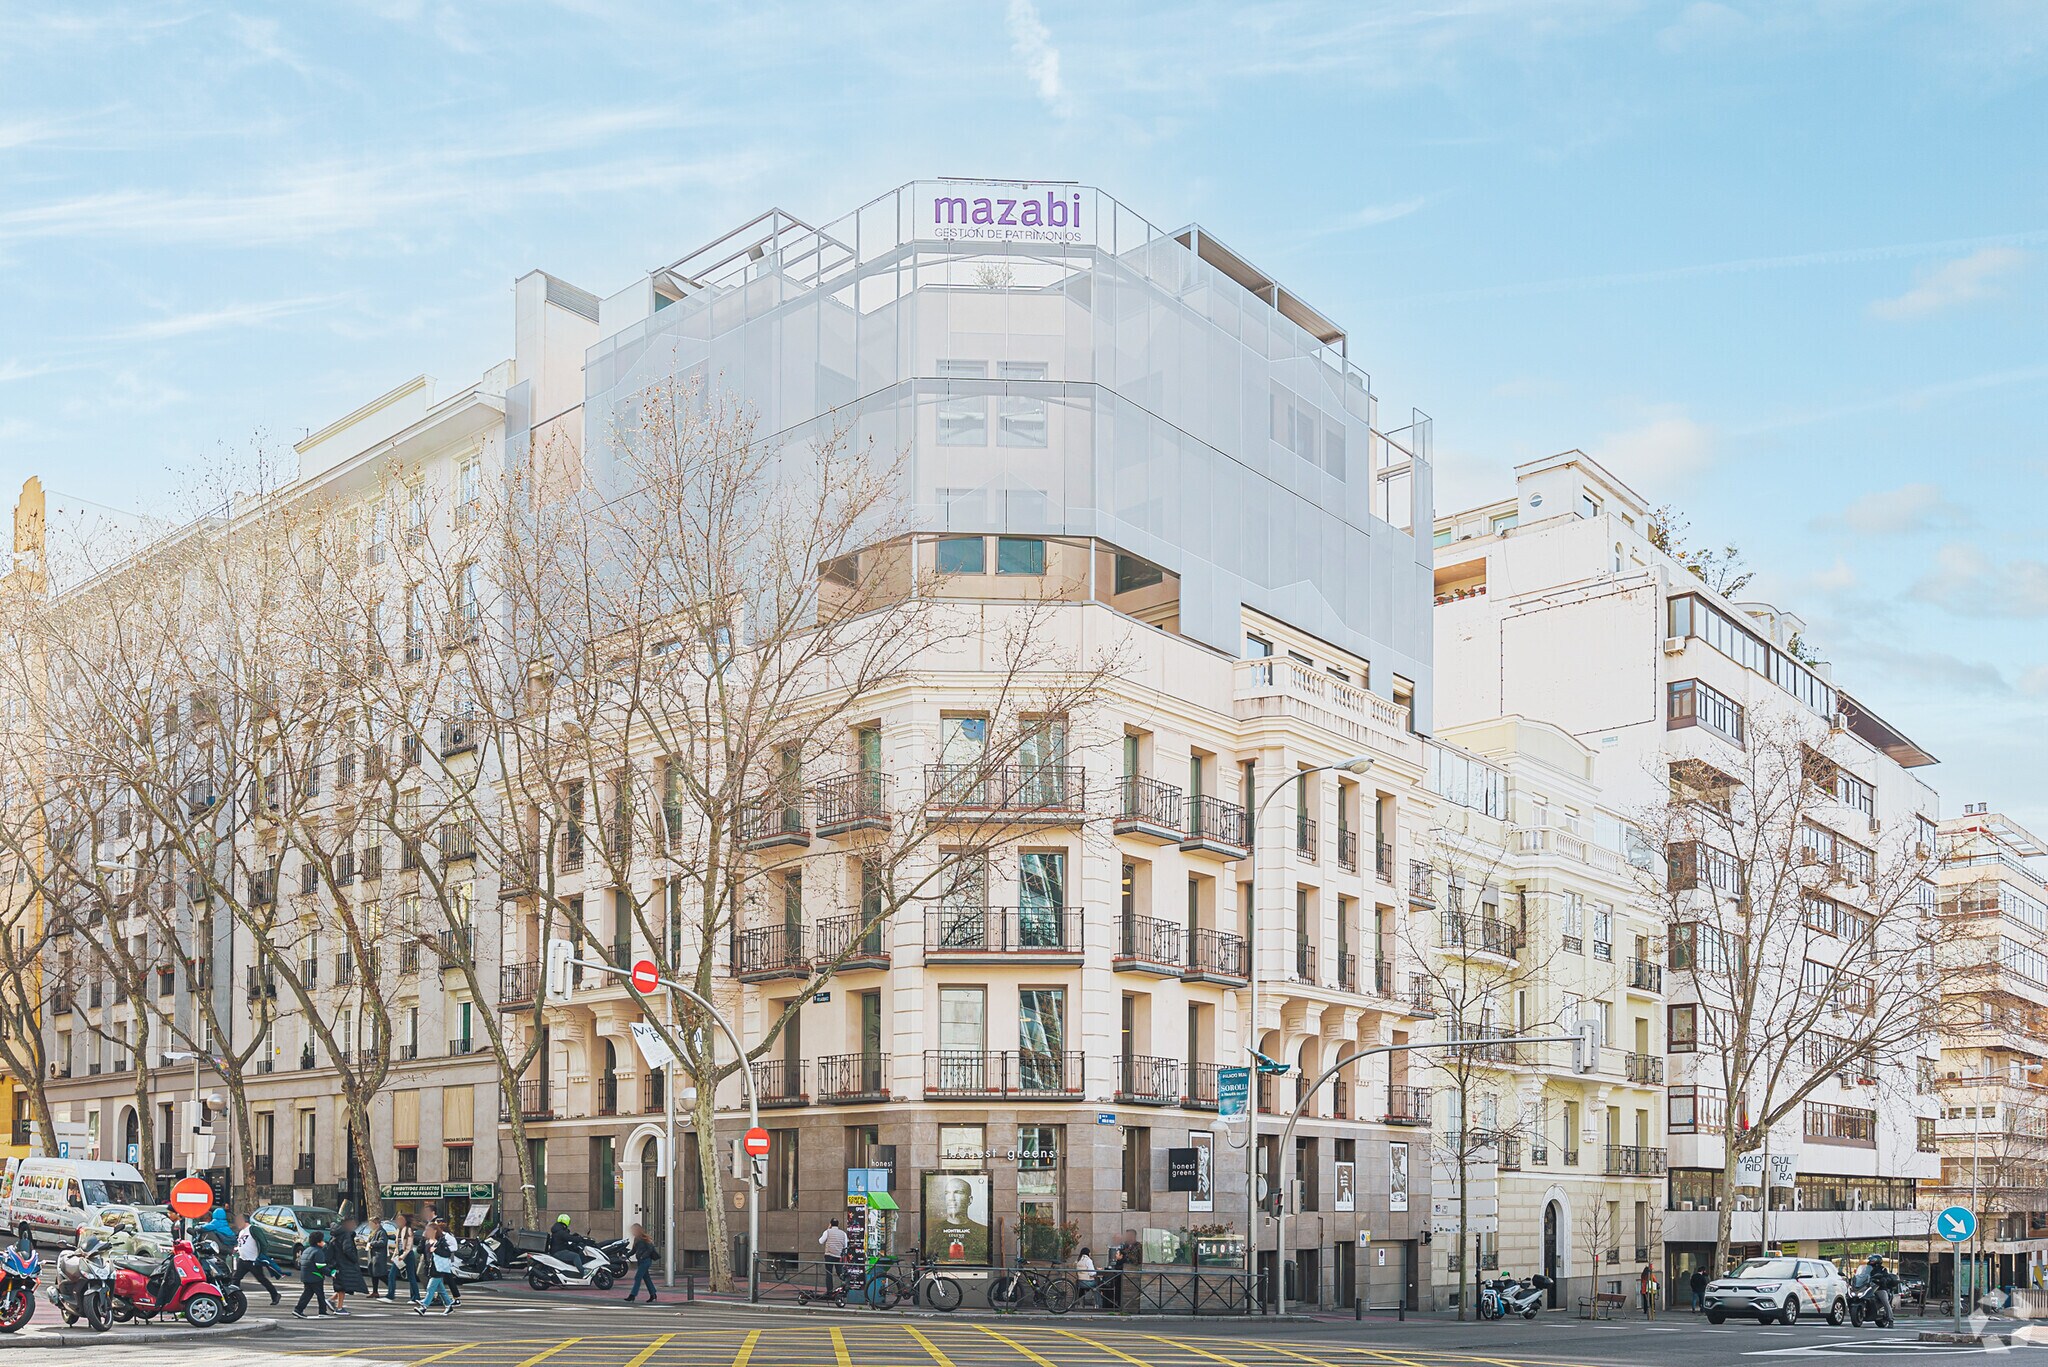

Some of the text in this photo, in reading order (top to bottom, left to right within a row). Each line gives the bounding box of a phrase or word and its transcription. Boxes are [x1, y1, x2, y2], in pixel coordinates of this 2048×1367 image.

[934, 191, 1080, 228] mazabi
[934, 227, 1081, 242] GESTIÓN DE PATRIMONIOS
[60, 1143, 68, 1158] P
[129, 1146, 136, 1162] P
[1007, 1149, 1054, 1161] greens
[871, 1159, 893, 1167] honest
[1737, 1155, 1763, 1164] MAD
[1771, 1155, 1792, 1165] CUL
[1744, 1163, 1762, 1172] RID
[1773, 1164, 1788, 1173] TU
[1171, 1170, 1196, 1178] greens
[1778, 1172, 1794, 1181] RA
